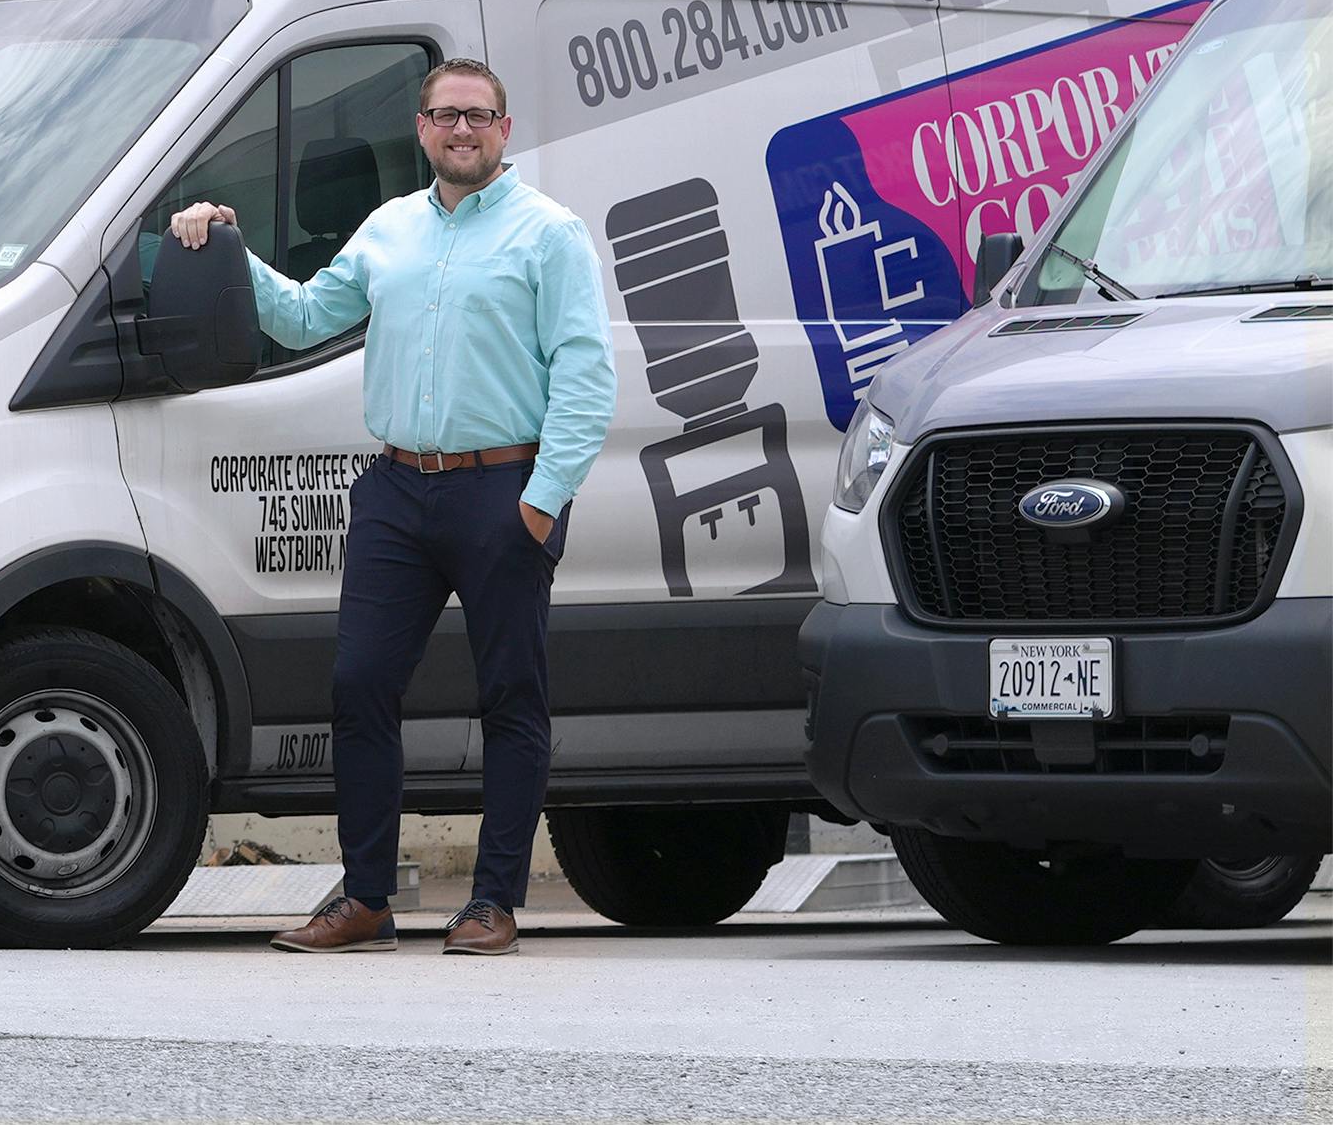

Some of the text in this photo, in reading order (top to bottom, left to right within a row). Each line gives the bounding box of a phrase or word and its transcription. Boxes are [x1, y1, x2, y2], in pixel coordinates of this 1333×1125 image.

[210, 455, 293, 493] CORPORATE
[296, 454, 349, 491] COFFEE
[259, 494, 346, 532] 745 SUMMA
[1034, 490, 1085, 516] Ford
[255, 535, 334, 576] WESTBURY,
[1020, 644, 1082, 657] NEW YORK
[999, 659, 1101, 697] 20912 NE
[1021, 702, 1078, 711] COMMERCIAL
[277, 732, 330, 770] US DOT
